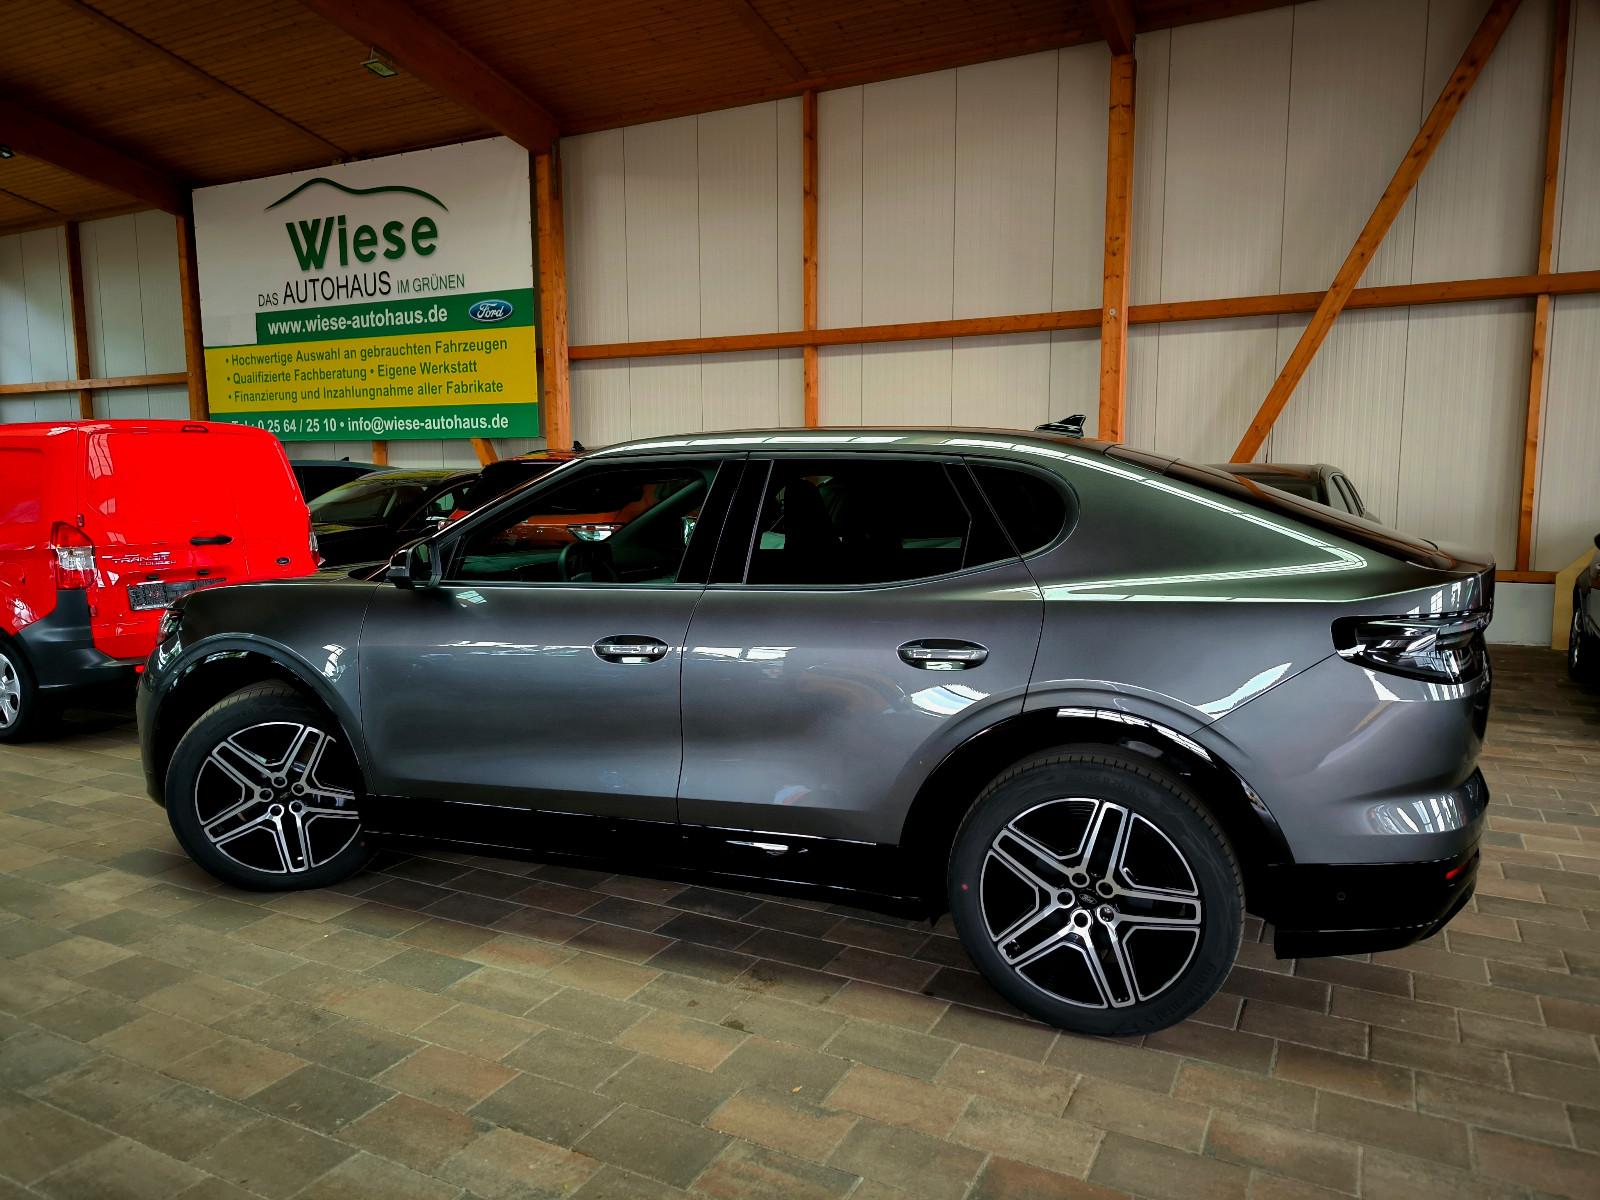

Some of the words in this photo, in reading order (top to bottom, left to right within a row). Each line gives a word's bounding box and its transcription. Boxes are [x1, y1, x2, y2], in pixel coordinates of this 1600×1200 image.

[285, 214, 438, 272] Wiese
[258, 293, 279, 307] DAS
[283, 270, 392, 305] AUTOHAUS
[397, 279, 410, 294] IM
[413, 273, 465, 292] GRÜNEN
[267, 304, 448, 335] www.wiese-autohaus.de
[477, 302, 504, 319] Ford
[231, 352, 293, 366] Hochwertige
[296, 347, 340, 362] Auswahl
[344, 348, 357, 359] an
[360, 343, 432, 361] gebrauchten
[435, 339, 508, 354] Fahrzeugen
[233, 370, 291, 385] Qualifizierte
[294, 366, 367, 381] Fachberatung
[377, 364, 417, 380] Eigene
[420, 360, 478, 375] Werkstatt
[234, 389, 298, 403] Finanzierung
[301, 387, 320, 400] und
[323, 384, 414, 400] Inzahlungnahme
[417, 382, 443, 396] aller
[446, 379, 504, 394] Fabrikate
[268, 419, 281, 433] 25
[283, 418, 297, 433] 64
[306, 418, 320, 432] 25
[324, 417, 337, 432] 10
[347, 413, 509, 435] info@wiese-autohaus.de
